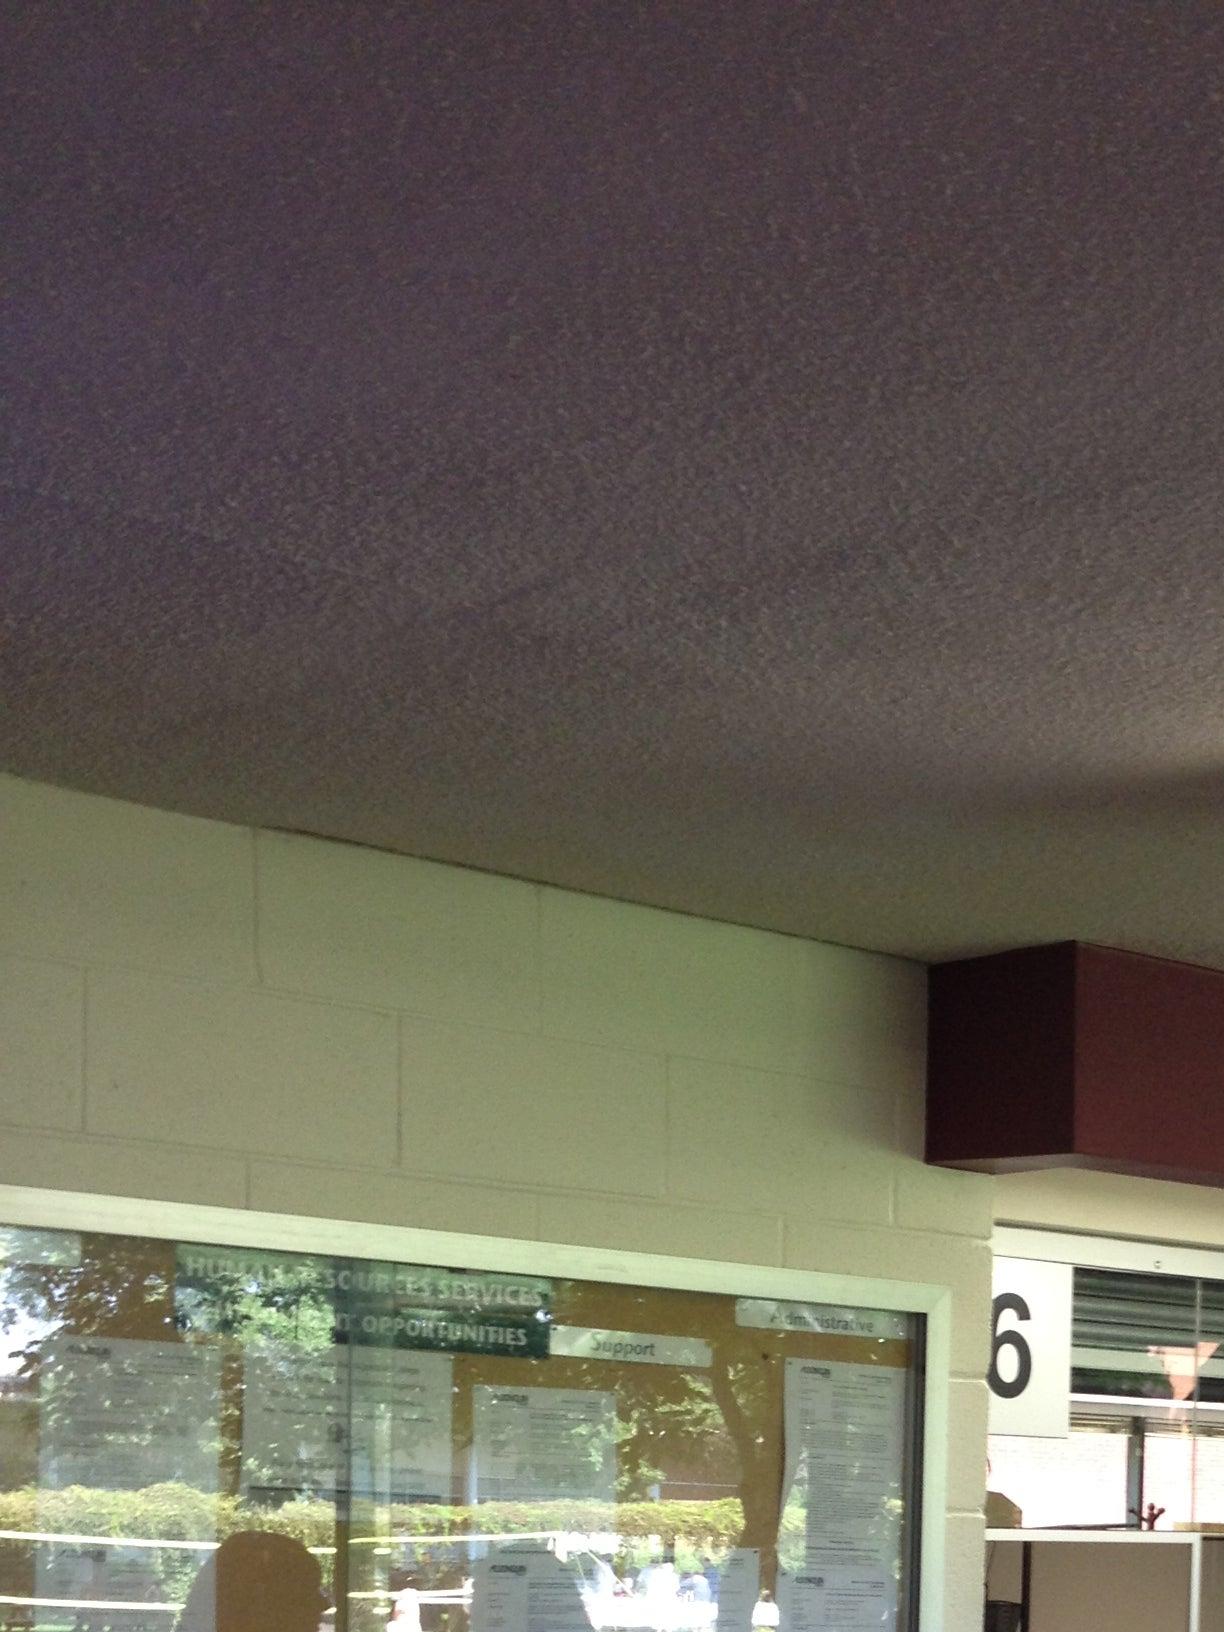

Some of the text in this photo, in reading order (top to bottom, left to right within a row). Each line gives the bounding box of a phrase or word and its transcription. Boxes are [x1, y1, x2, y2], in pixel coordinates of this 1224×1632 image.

[361, 1315, 528, 1346] OPPORTUNITIES
[590, 1331, 656, 1358] Support
[987, 1292, 1032, 1399] 6
